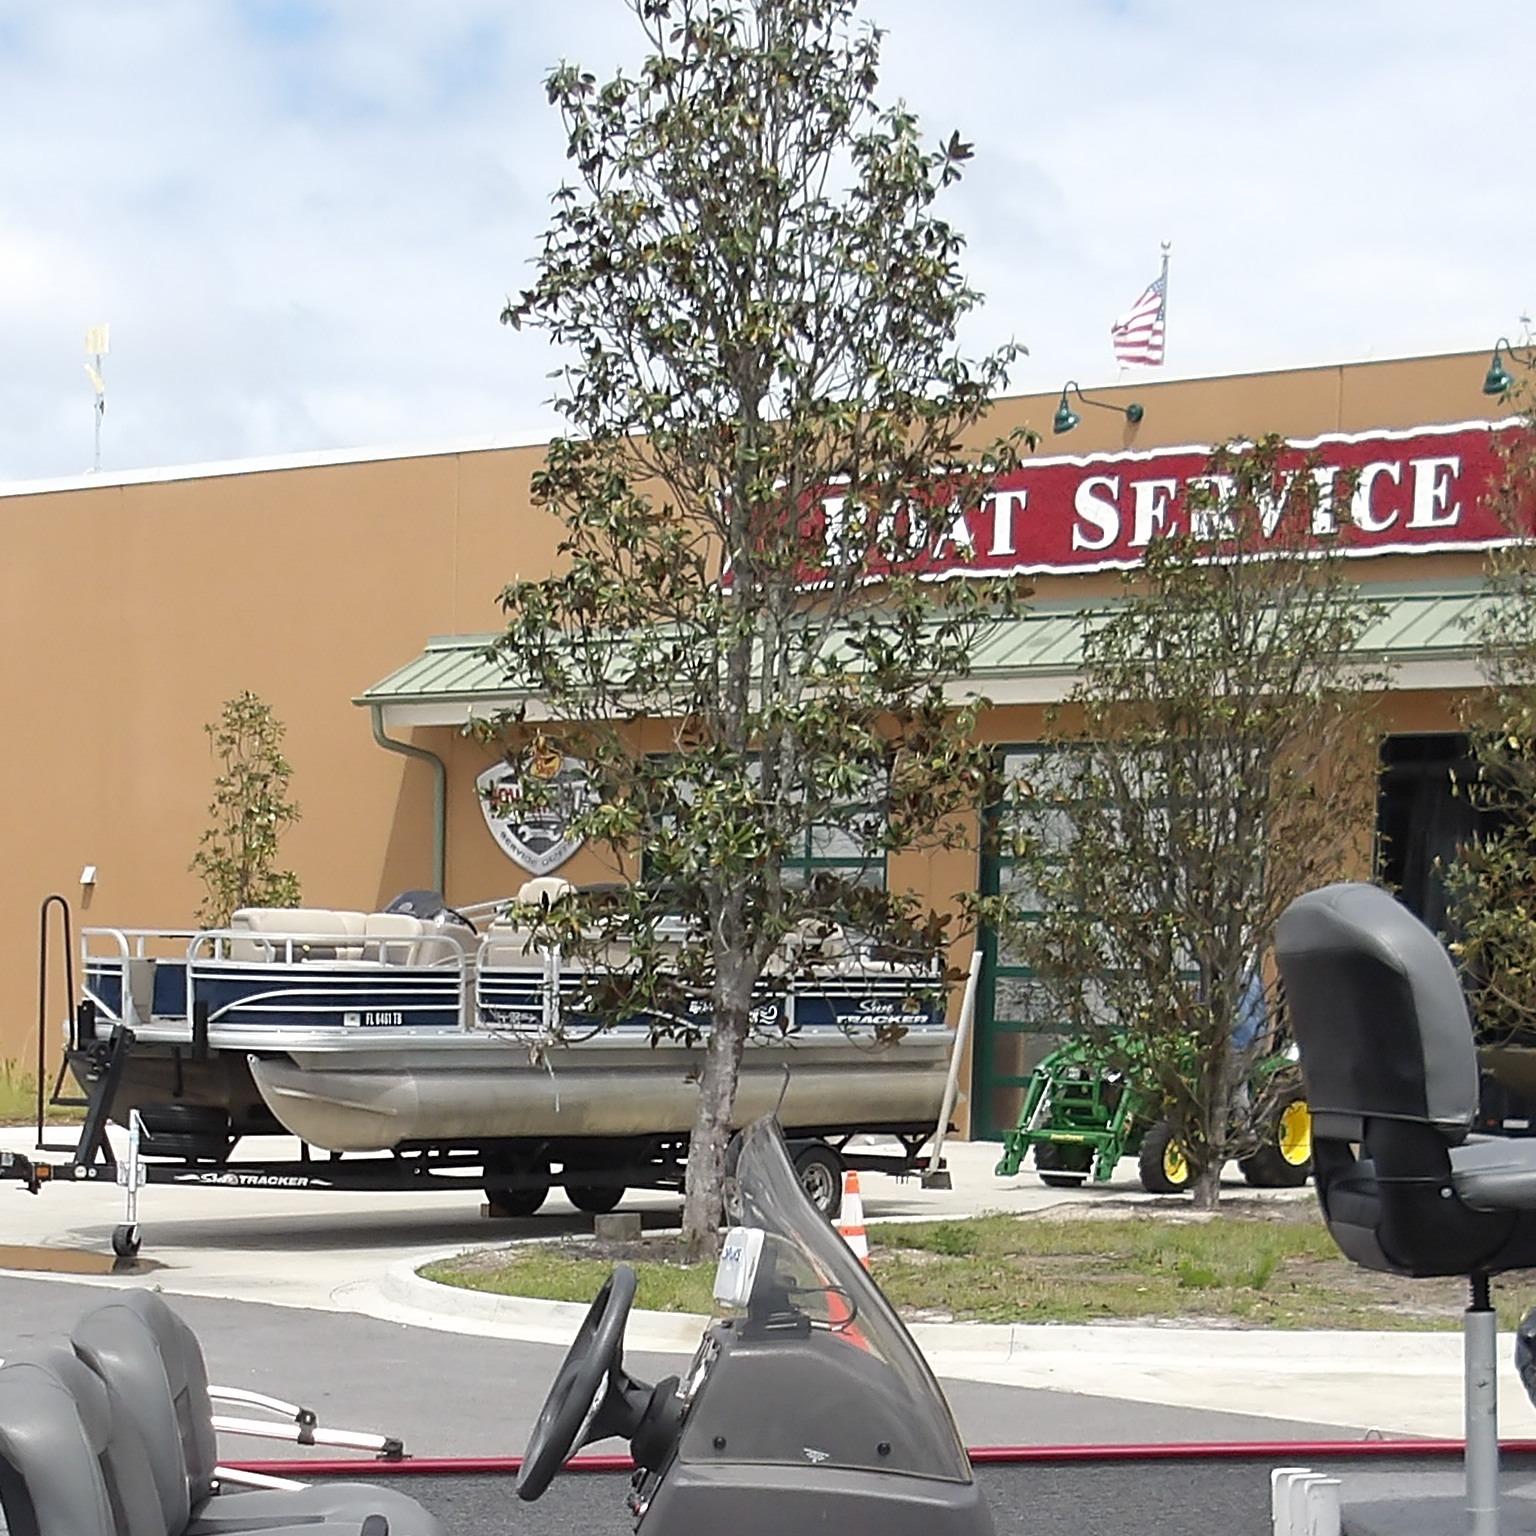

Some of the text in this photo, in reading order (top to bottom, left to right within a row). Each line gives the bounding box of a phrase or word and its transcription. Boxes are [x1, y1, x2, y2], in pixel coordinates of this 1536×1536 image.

[1071, 455, 1462, 551] SERVICE
[836, 1014, 929, 1024] TRACKER
[239, 1174, 309, 1187] TRACKER
